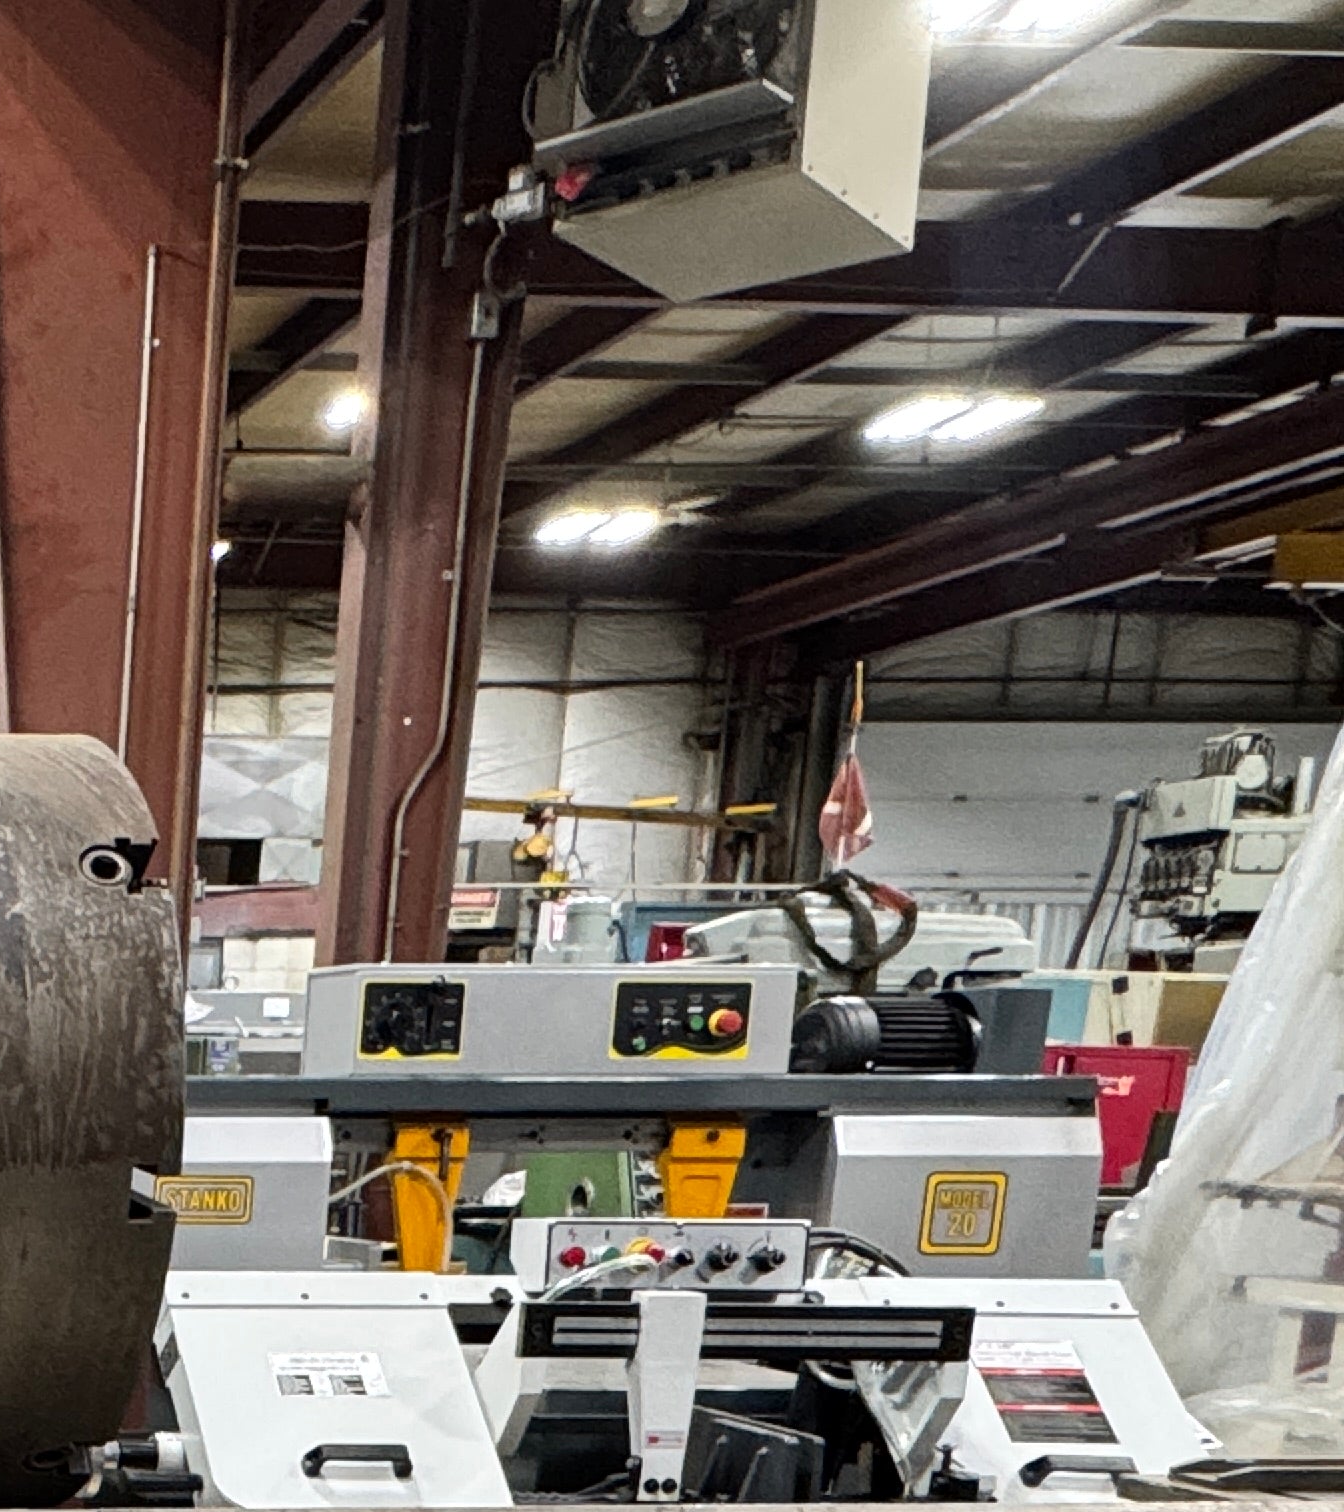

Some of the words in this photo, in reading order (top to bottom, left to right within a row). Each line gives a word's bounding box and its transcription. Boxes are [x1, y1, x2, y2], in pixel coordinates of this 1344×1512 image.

[166, 1188, 241, 1211] STANKO
[940, 1190, 990, 1209] MODEL
[948, 1212, 976, 1237] 20
